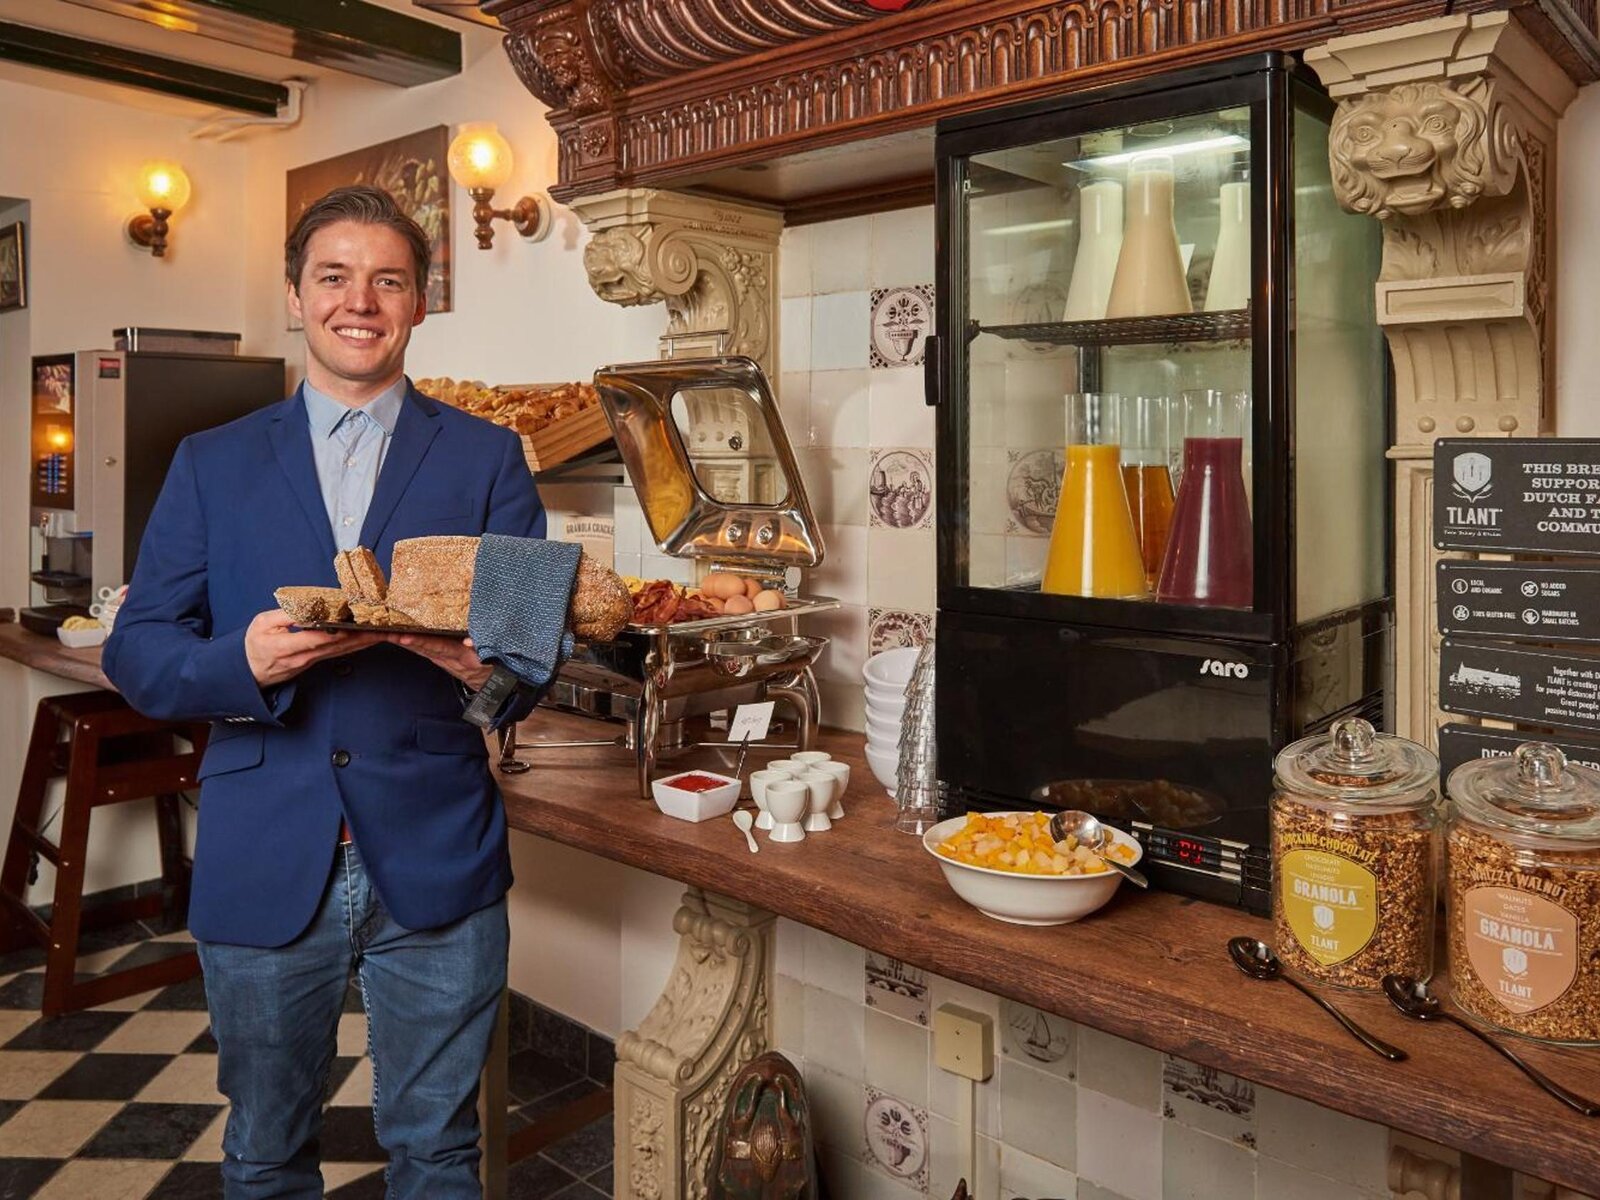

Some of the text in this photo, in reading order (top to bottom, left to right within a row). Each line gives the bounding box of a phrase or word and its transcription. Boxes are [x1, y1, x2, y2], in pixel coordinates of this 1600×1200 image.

[1522, 463, 1600, 474] THIS BRE
[1532, 478, 1600, 490] SUPPOR
[1522, 492, 1581, 504] DUTCH
[1446, 506, 1502, 526] TLANT
[1548, 506, 1587, 518] AND
[1536, 521, 1600, 534] COMMU
[1200, 658, 1249, 679] saro
[1547, 676, 1566, 686] TLANT
[1546, 686, 1567, 697] people
[1560, 698, 1600, 710] Great people
[1320, 836, 1380, 865] CHOCOLATE
[1294, 878, 1357, 906] GRANOLA
[1469, 868, 1569, 902] WHIZZY WALNUT
[1480, 917, 1556, 951] GRANOLA
[1310, 934, 1340, 951] TLANT
[1499, 978, 1533, 998] TLANT
